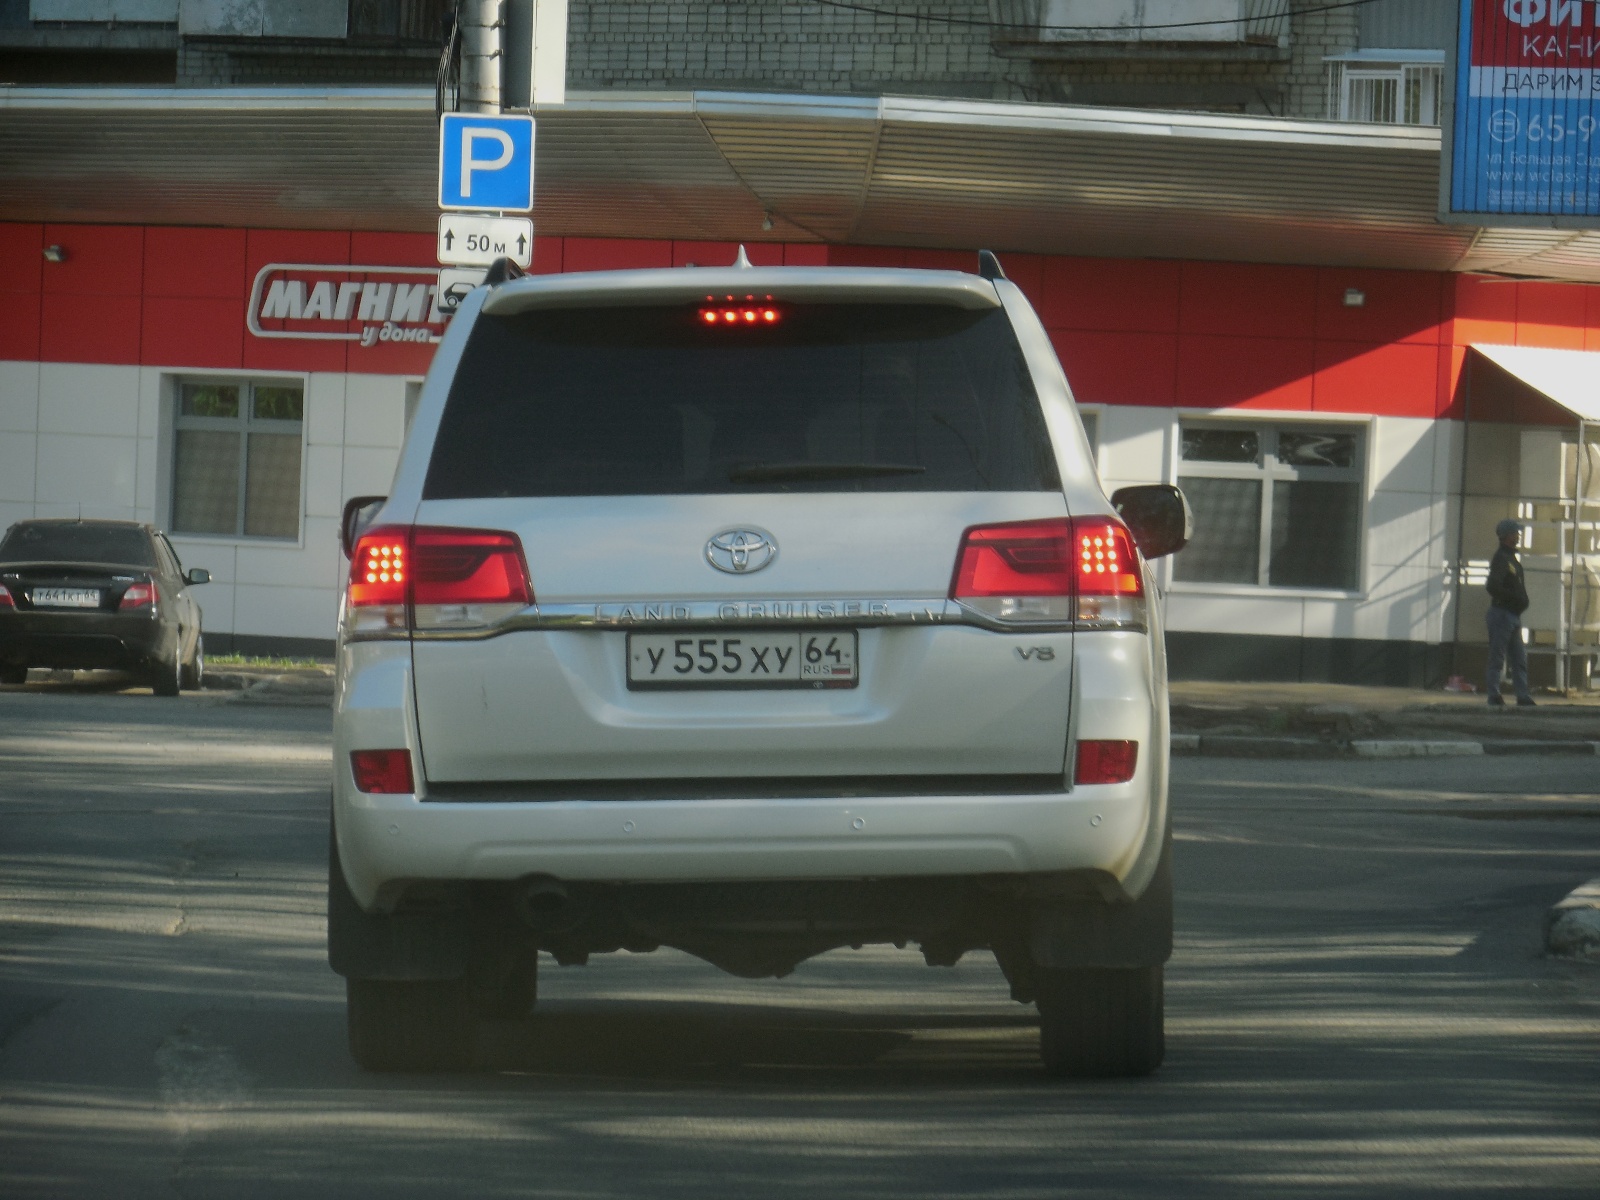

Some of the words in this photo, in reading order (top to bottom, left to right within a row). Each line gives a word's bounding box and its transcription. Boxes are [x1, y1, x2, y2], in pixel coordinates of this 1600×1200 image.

[1503, 0, 1600, 27] ФИ
[1502, 73, 1583, 93] ДАРИМ
[1528, 114, 1600, 142] 65-9
[460, 126, 514, 198] P
[1510, 151, 1571, 166] Большая
[466, 234, 490, 252] 50
[361, 326, 378, 347] у
[379, 321, 430, 343] дома
[594, 604, 690, 622] LAND
[718, 602, 888, 620] CRUISER
[805, 637, 841, 663] 64
[1015, 645, 1056, 661] V8
[803, 664, 830, 675] RUS
